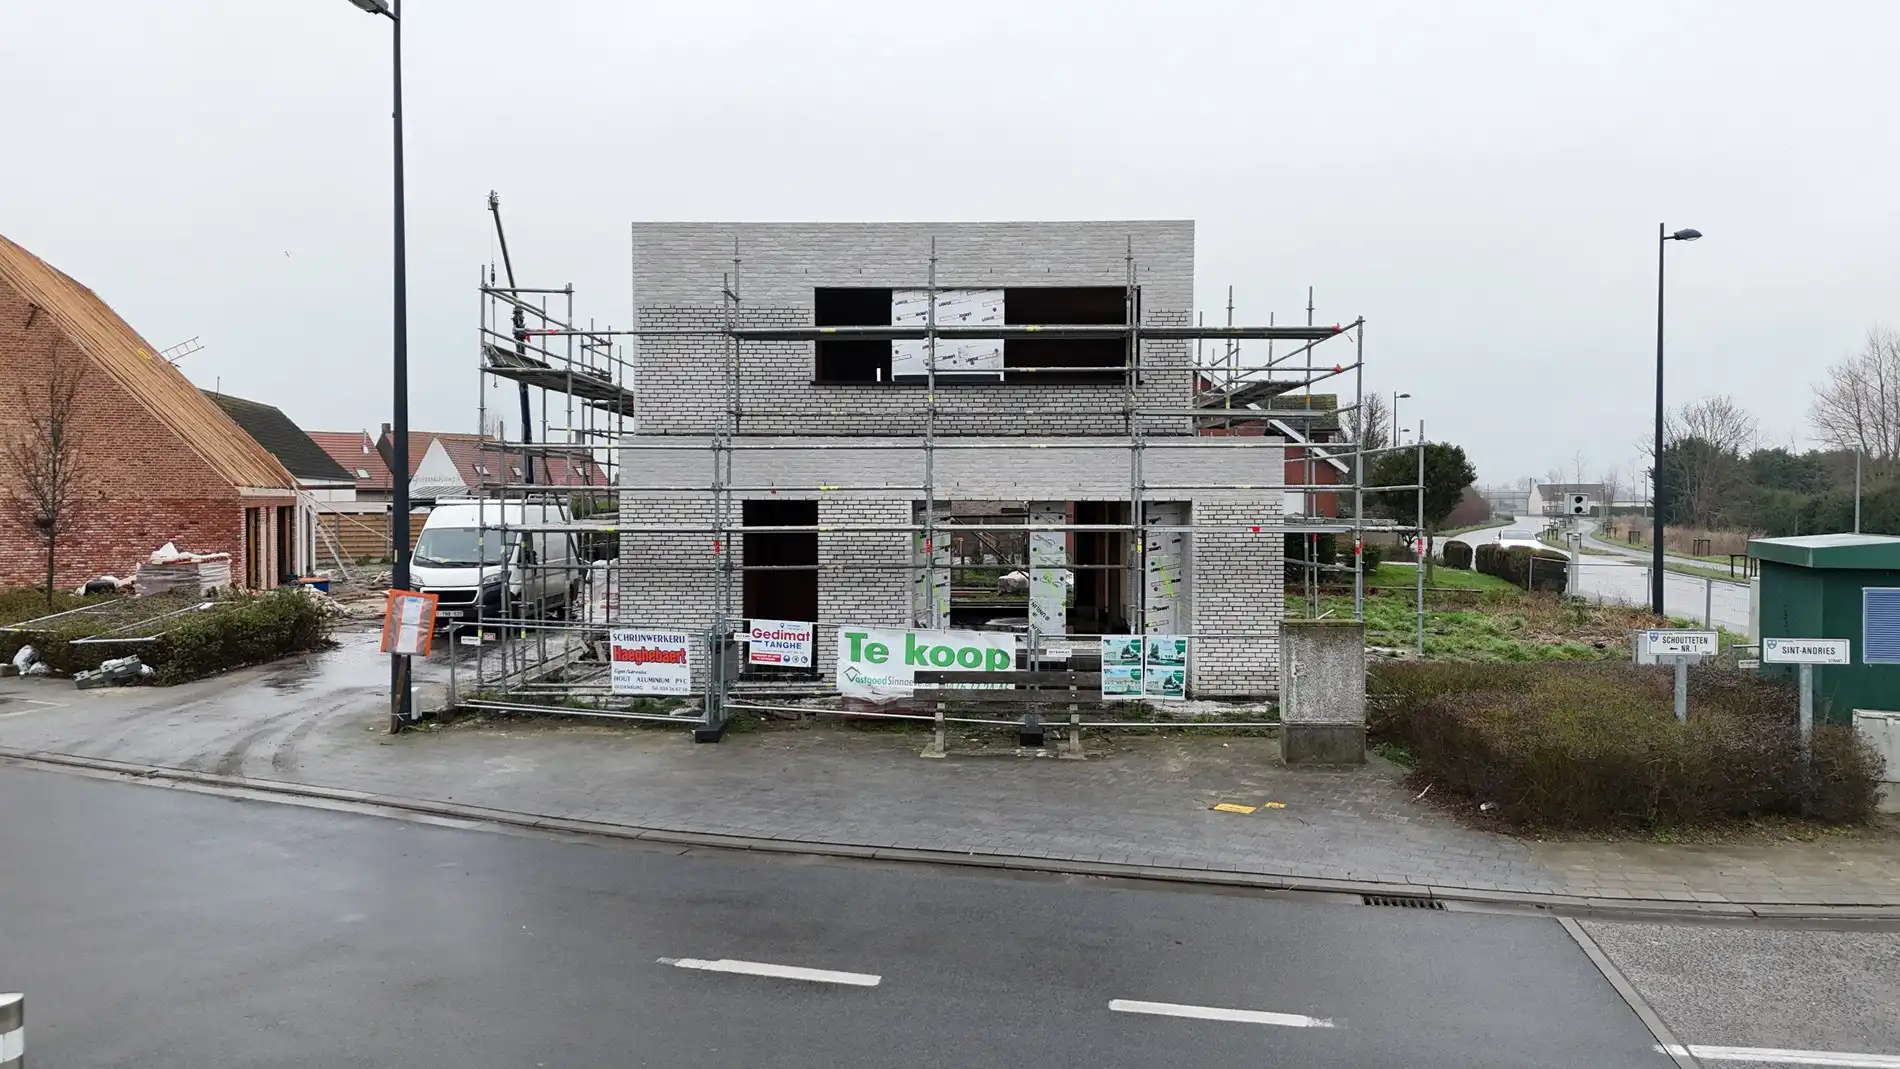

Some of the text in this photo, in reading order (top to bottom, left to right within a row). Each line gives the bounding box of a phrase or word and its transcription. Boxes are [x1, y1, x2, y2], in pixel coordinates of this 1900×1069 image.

[613, 633, 685, 643] SCHRIJNWERKERIJ
[752, 628, 810, 641] Gedimat
[764, 641, 802, 649] TANGHE
[1662, 636, 1708, 644] SCHOUTTETEN
[613, 645, 686, 665] Haeghebaert
[845, 632, 1011, 672] Te koop
[1782, 646, 1836, 655] SINT-ANDRIES
